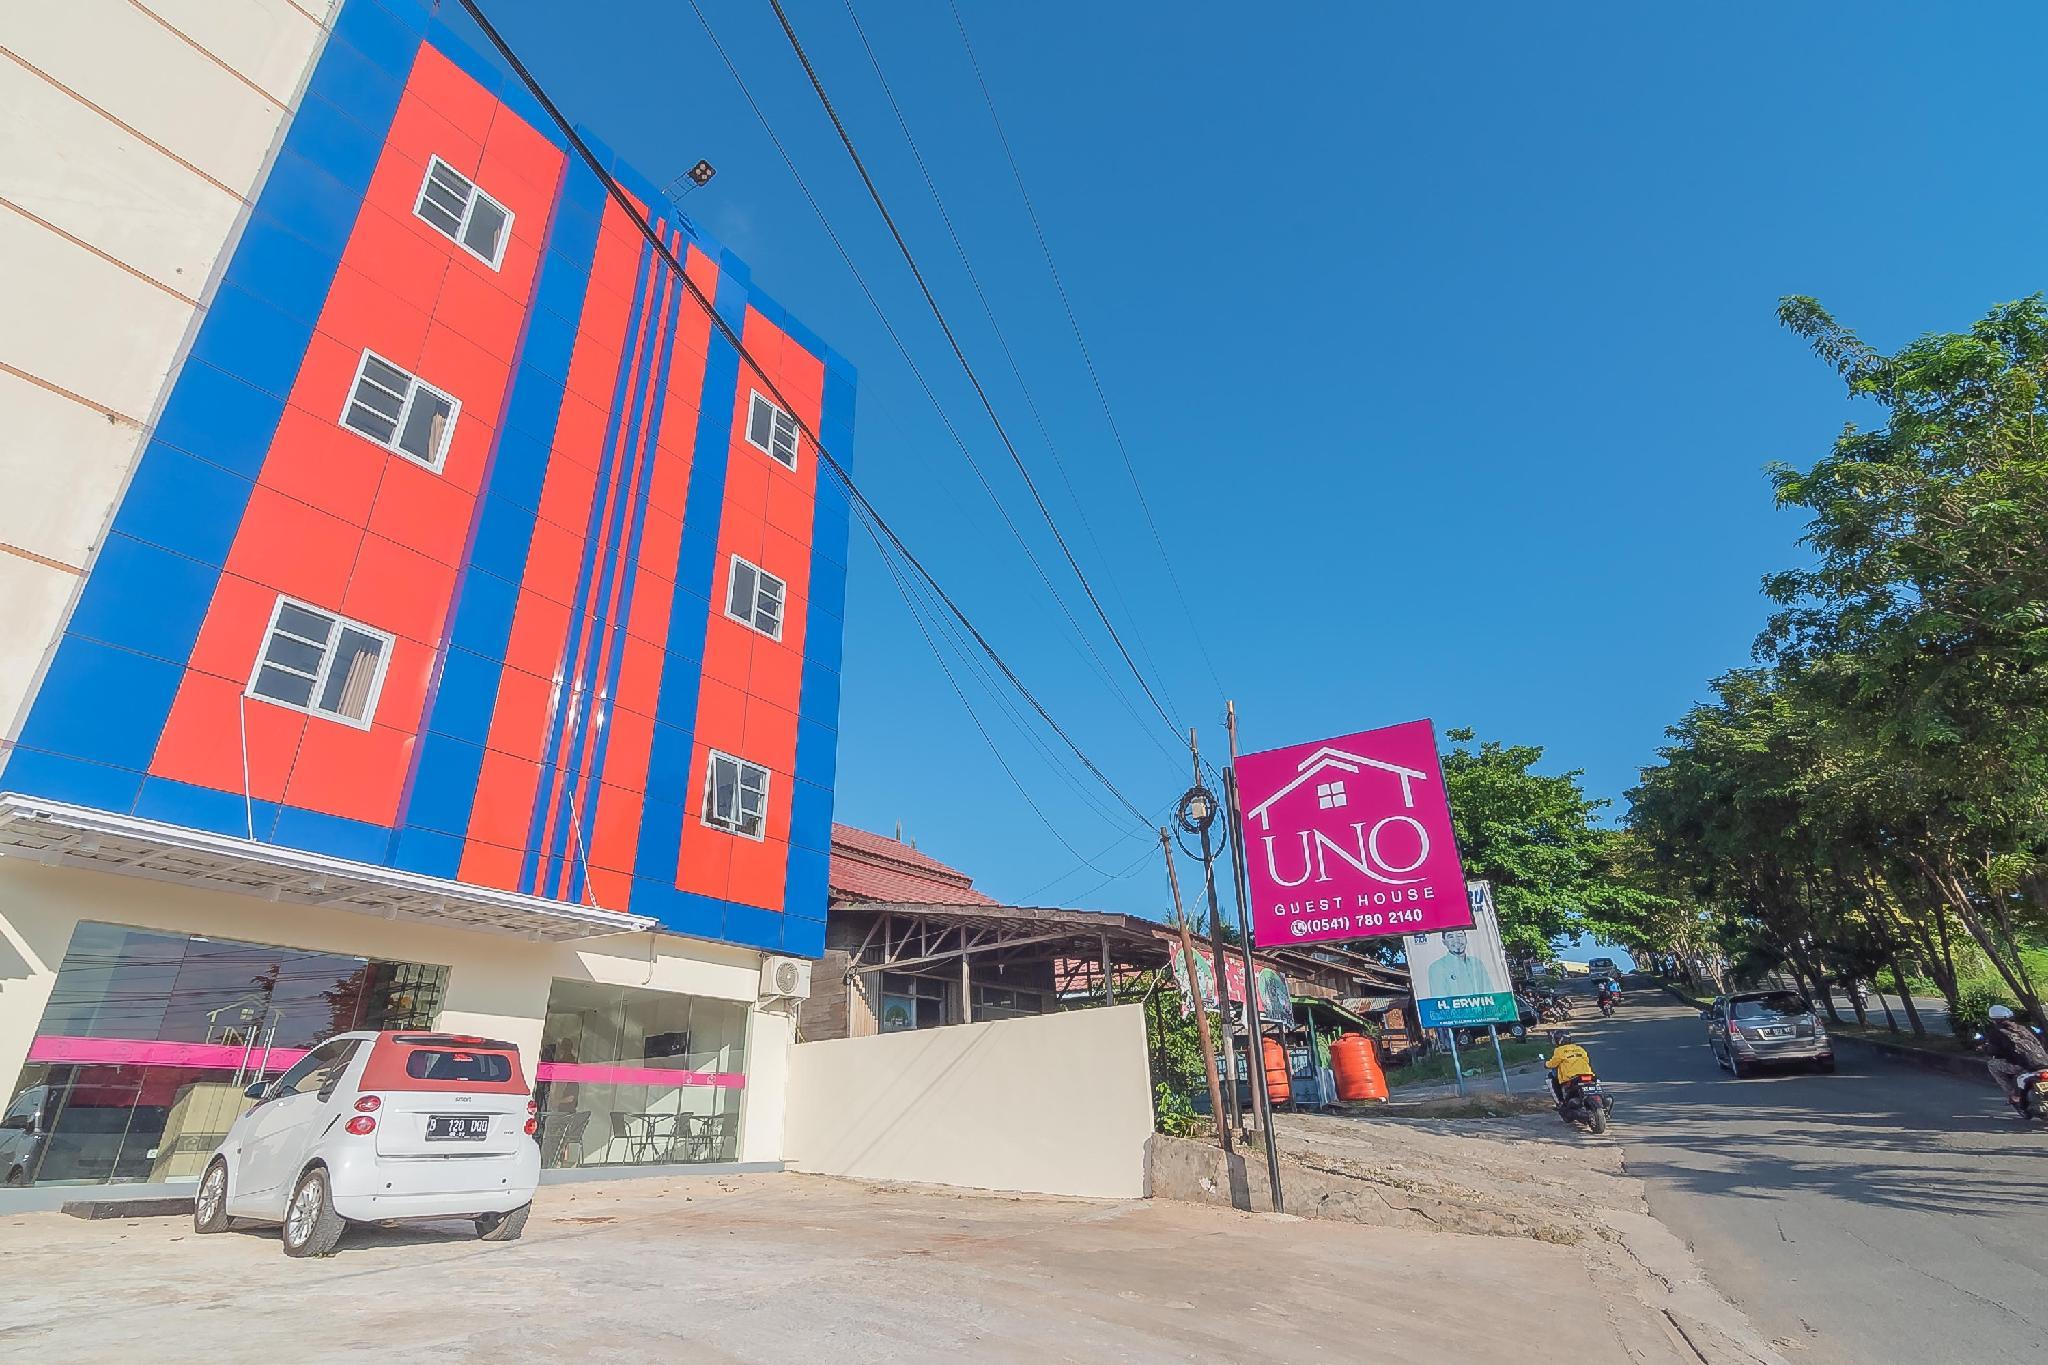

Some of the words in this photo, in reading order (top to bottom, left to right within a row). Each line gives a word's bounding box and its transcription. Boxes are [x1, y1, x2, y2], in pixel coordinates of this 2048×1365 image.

[1261, 815, 1430, 887] UNO
[1274, 896, 1344, 916] GUEST
[1358, 886, 1435, 906] HOUSE
[1307, 916, 1350, 933] (0541)
[1356, 913, 1383, 927] 780
[1389, 908, 1423, 925] 2140
[1452, 996, 1495, 1009] ERWIN
